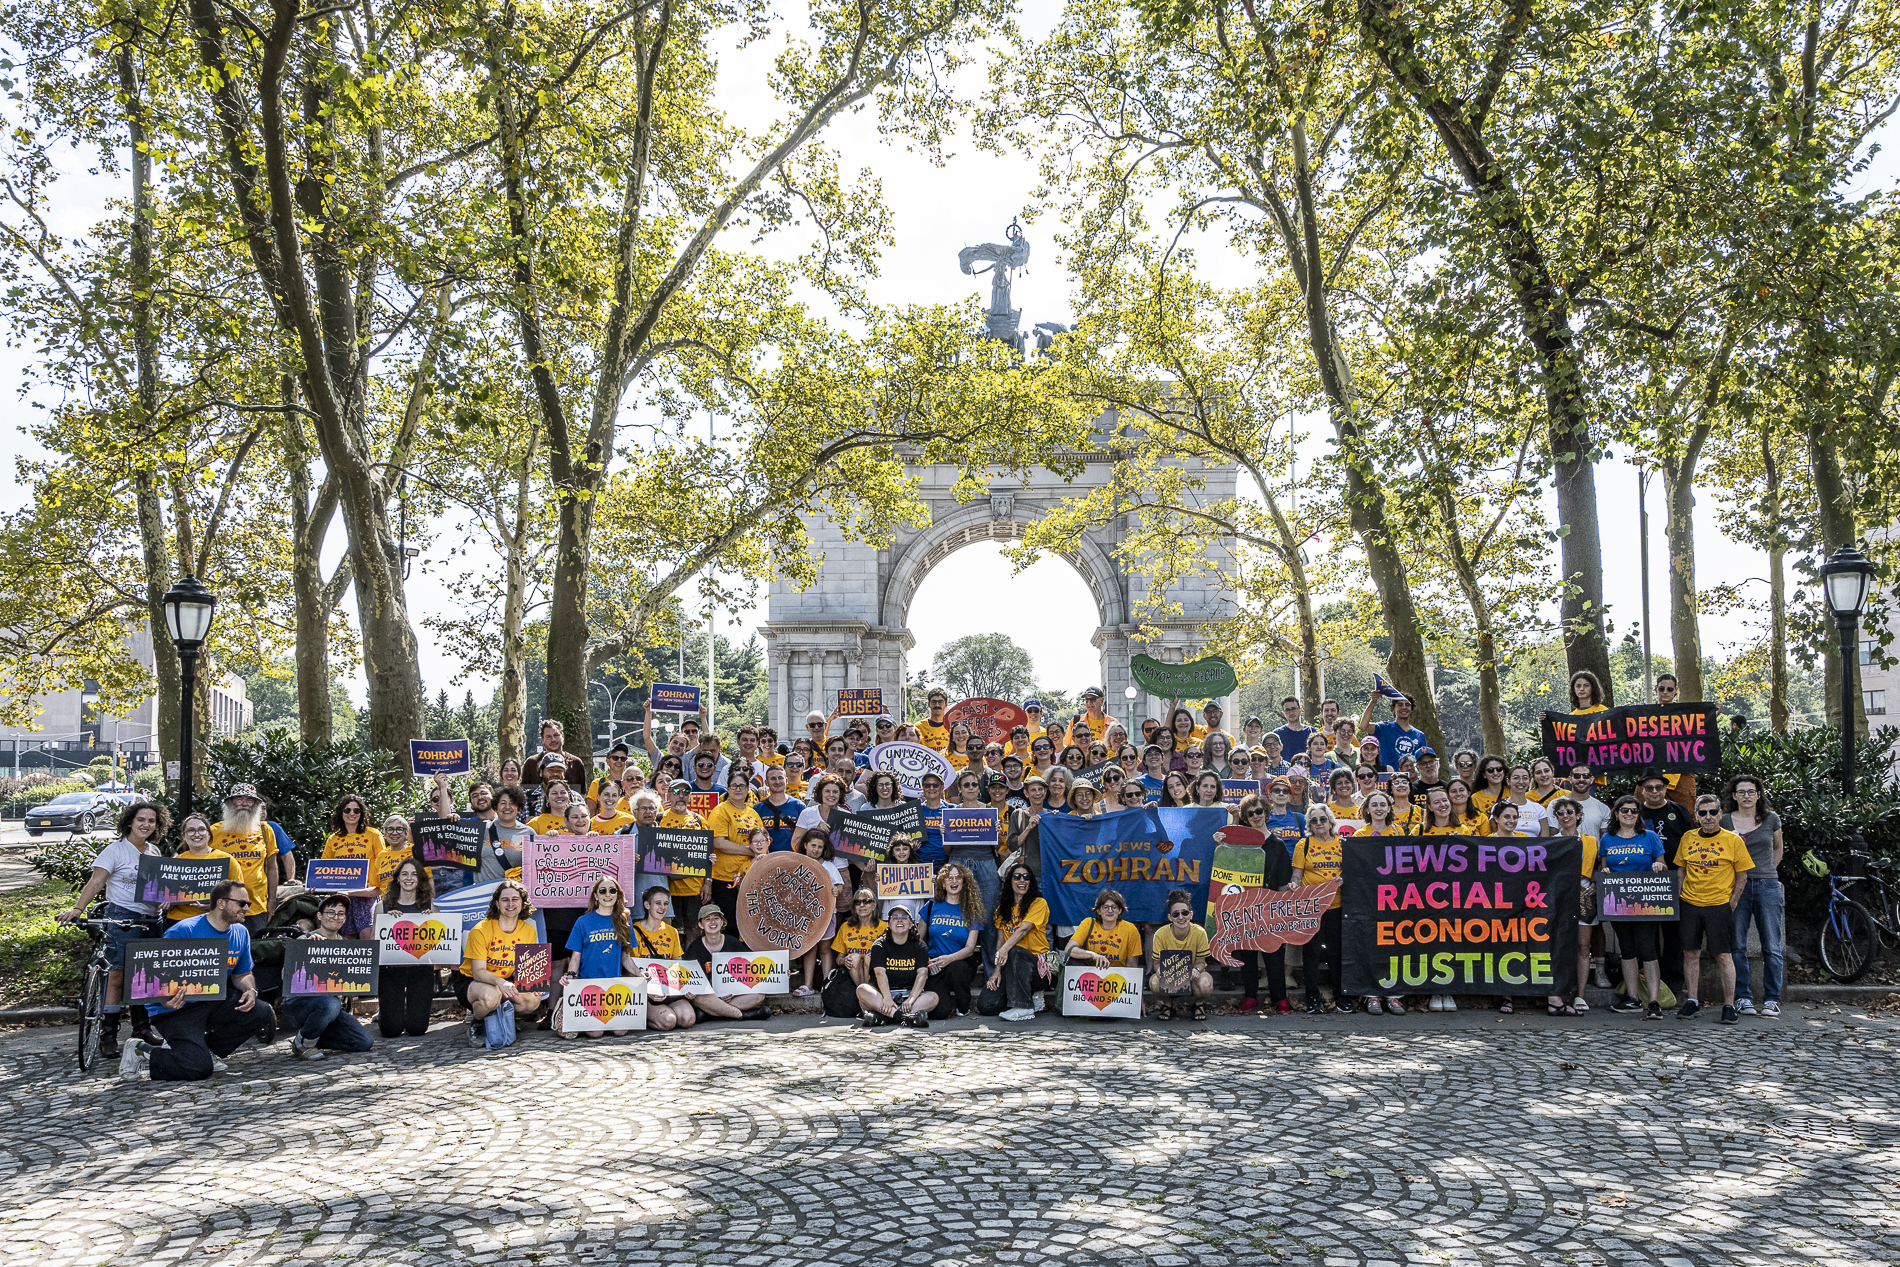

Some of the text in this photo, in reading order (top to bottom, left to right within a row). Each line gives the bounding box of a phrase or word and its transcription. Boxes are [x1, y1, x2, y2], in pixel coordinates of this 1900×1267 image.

[1133, 661, 1138, 670] A
[1138, 664, 1172, 684] MAYOR
[1194, 668, 1226, 682] PEOPLE
[657, 690, 695, 699] ZOHRAN
[840, 690, 880, 698] FAST FREE
[840, 700, 880, 714] BUSES
[962, 704, 988, 716] FAST
[968, 716, 996, 727] FREE
[1552, 714, 1706, 742] WE ALL DESERVE
[1400, 744, 1410, 752] UFT
[1556, 740, 1706, 766] TO AFFORD NYC
[417, 750, 462, 760] ZOHRAN
[1222, 788, 1254, 796] OHRAN
[420, 824, 440, 834] JEWS
[456, 826, 480, 834] RACIAL
[844, 818, 891, 836] IMMIGRANTS
[903, 821, 920, 830] HERE
[949, 818, 992, 828] ZOHRAN
[656, 832, 708, 844] IMMIGRANTS
[858, 830, 890, 843] WELCOME
[536, 844, 560, 852] TWO
[673, 843, 708, 852] WELCOME
[870, 841, 888, 850] HERE
[1086, 842, 1172, 854] NYC JEWS FOR
[688, 852, 707, 860] HERE
[1376, 844, 1548, 875] JEWS FOR
[588, 857, 612, 868] BUT
[160, 864, 223, 874] IMMIGRANTS
[314, 867, 361, 876] ZOHRAN
[1059, 857, 1201, 884] ZOHRAN
[538, 872, 602, 884] HOLD THE
[794, 864, 824, 892] NEW
[882, 866, 930, 885] CHILDCARE
[1213, 870, 1261, 884] DONE WITH
[534, 886, 591, 897] CORRUPT
[775, 867, 824, 918] YORKERS
[883, 881, 930, 894] FOR ALL
[1378, 882, 1512, 910] RACIAL
[1524, 880, 1548, 908] &
[746, 890, 760, 916] THE
[762, 886, 810, 932] DESERVE
[1221, 898, 1320, 930] RENT FREEZE
[932, 918, 967, 927] ZOHRAN
[380, 928, 458, 940] CARE FOR ALL
[758, 918, 802, 950] WORKS
[1218, 932, 1242, 947] MAKE
[1270, 922, 1286, 933] LOX
[1288, 916, 1320, 931] BETTER!
[1376, 917, 1550, 945] ECONOMIC
[133, 948, 220, 960] JEWS FOR RACIAL
[308, 947, 372, 956] IMMIGRANTS
[519, 950, 530, 960] WE
[162, 958, 220, 968] ECONOMIC
[518, 949, 549, 972] SCHMOOZE.
[1175, 955, 1190, 971] HOPES
[180, 969, 220, 978] JUSTICE
[348, 966, 372, 974] HERE
[518, 958, 548, 981] FASCISTS
[686, 970, 703, 978] ALL
[716, 964, 786, 974] CARE FOR ALL
[1378, 952, 1554, 989] JUSTICE
[526, 968, 546, 984] LOSE.
[756, 976, 780, 984] SMALL
[1174, 973, 1190, 987] FEARS
[1068, 979, 1138, 995] CARE FOR ALL
[568, 994, 644, 1006] CARE FOR ALL
[1107, 996, 1132, 1004] SMALL
